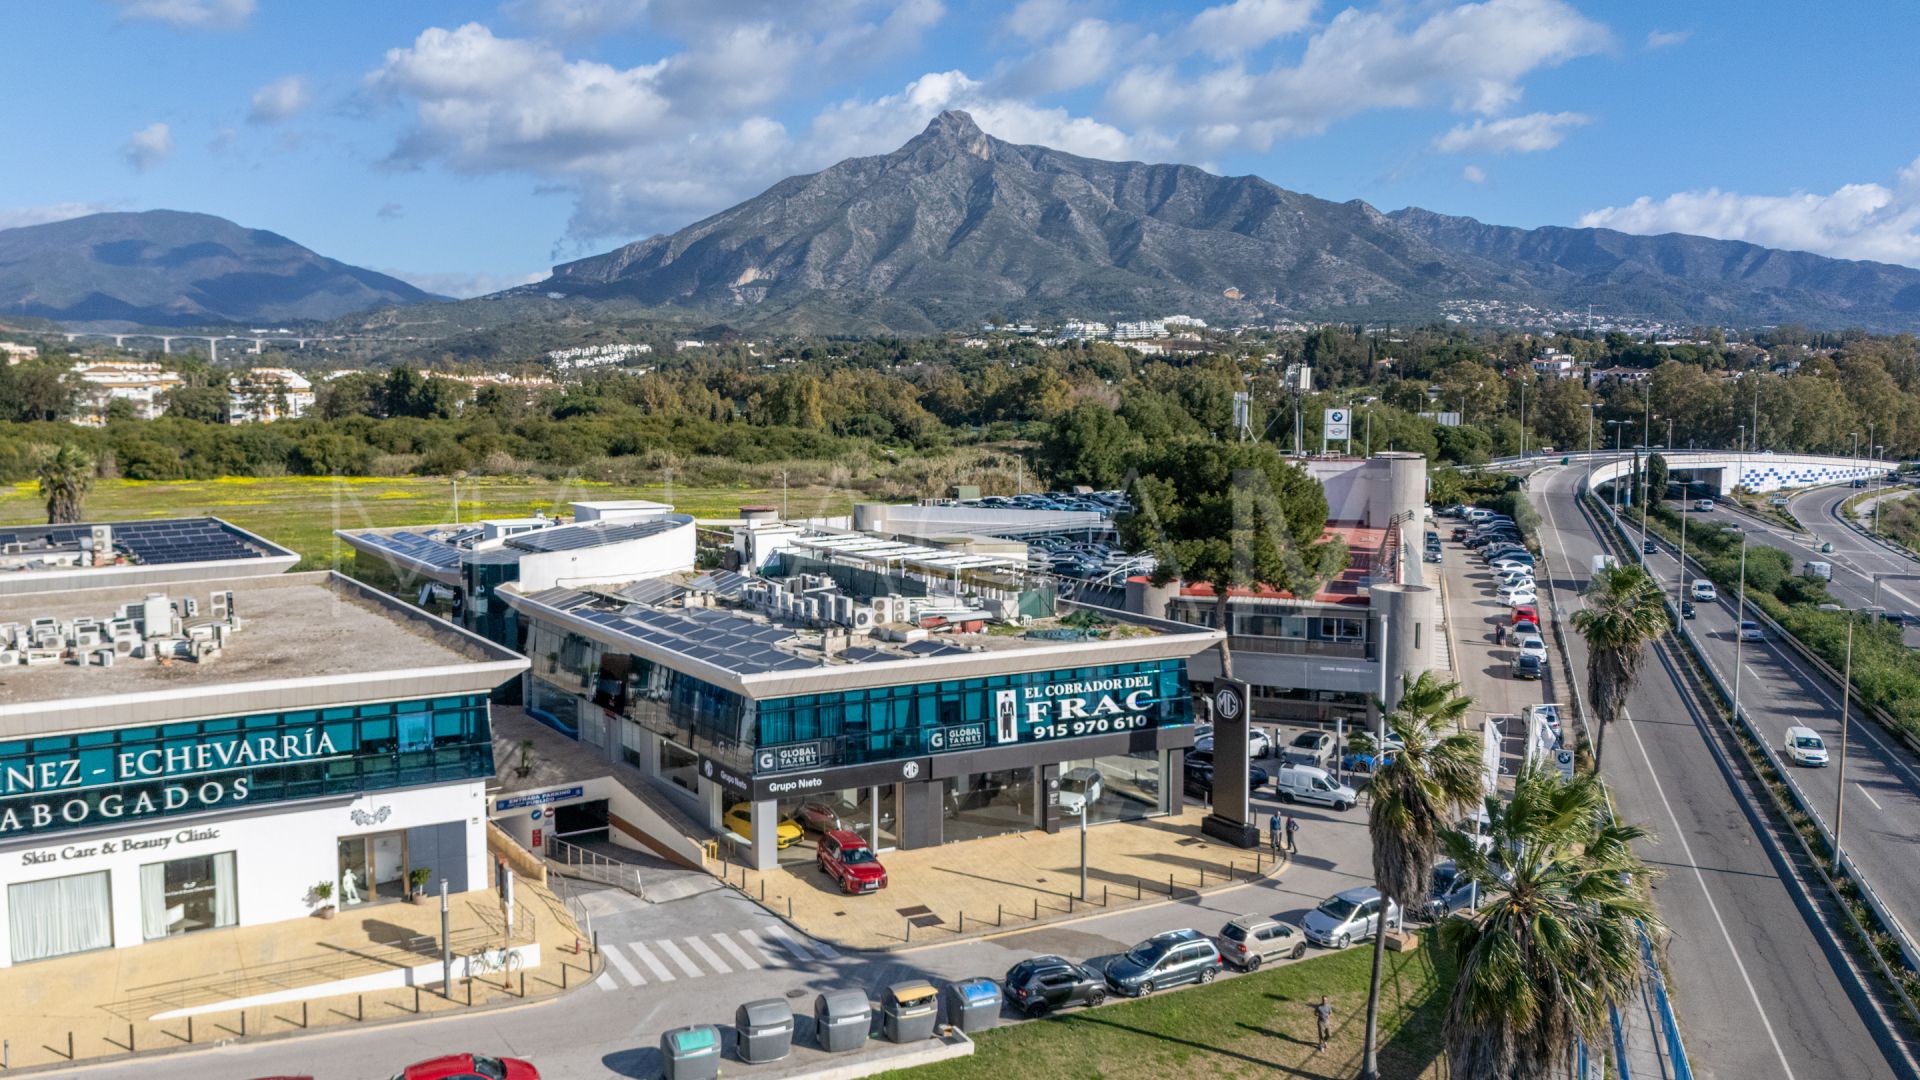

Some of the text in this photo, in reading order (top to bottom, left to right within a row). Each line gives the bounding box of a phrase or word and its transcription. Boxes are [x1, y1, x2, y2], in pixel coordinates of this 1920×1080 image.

[1024, 675, 1152, 699] EL COBRADOR DEL
[1025, 689, 1154, 724] FRAC
[949, 727, 981, 738] GLOBAL
[1033, 714, 1147, 739] 915 970 610
[949, 734, 981, 745] TAXNET
[0, 759, 83, 793] NEZ
[118, 728, 338, 778] ECHEVARRÍA
[760, 753, 773, 769] G
[780, 746, 816, 758] GLOBAL
[780, 754, 817, 765] TAXNET
[769, 778, 822, 793] Grupo Nieto
[0, 778, 249, 832] ABOGADOS
[21, 828, 221, 866] Skin Care & Beauty Clinic
